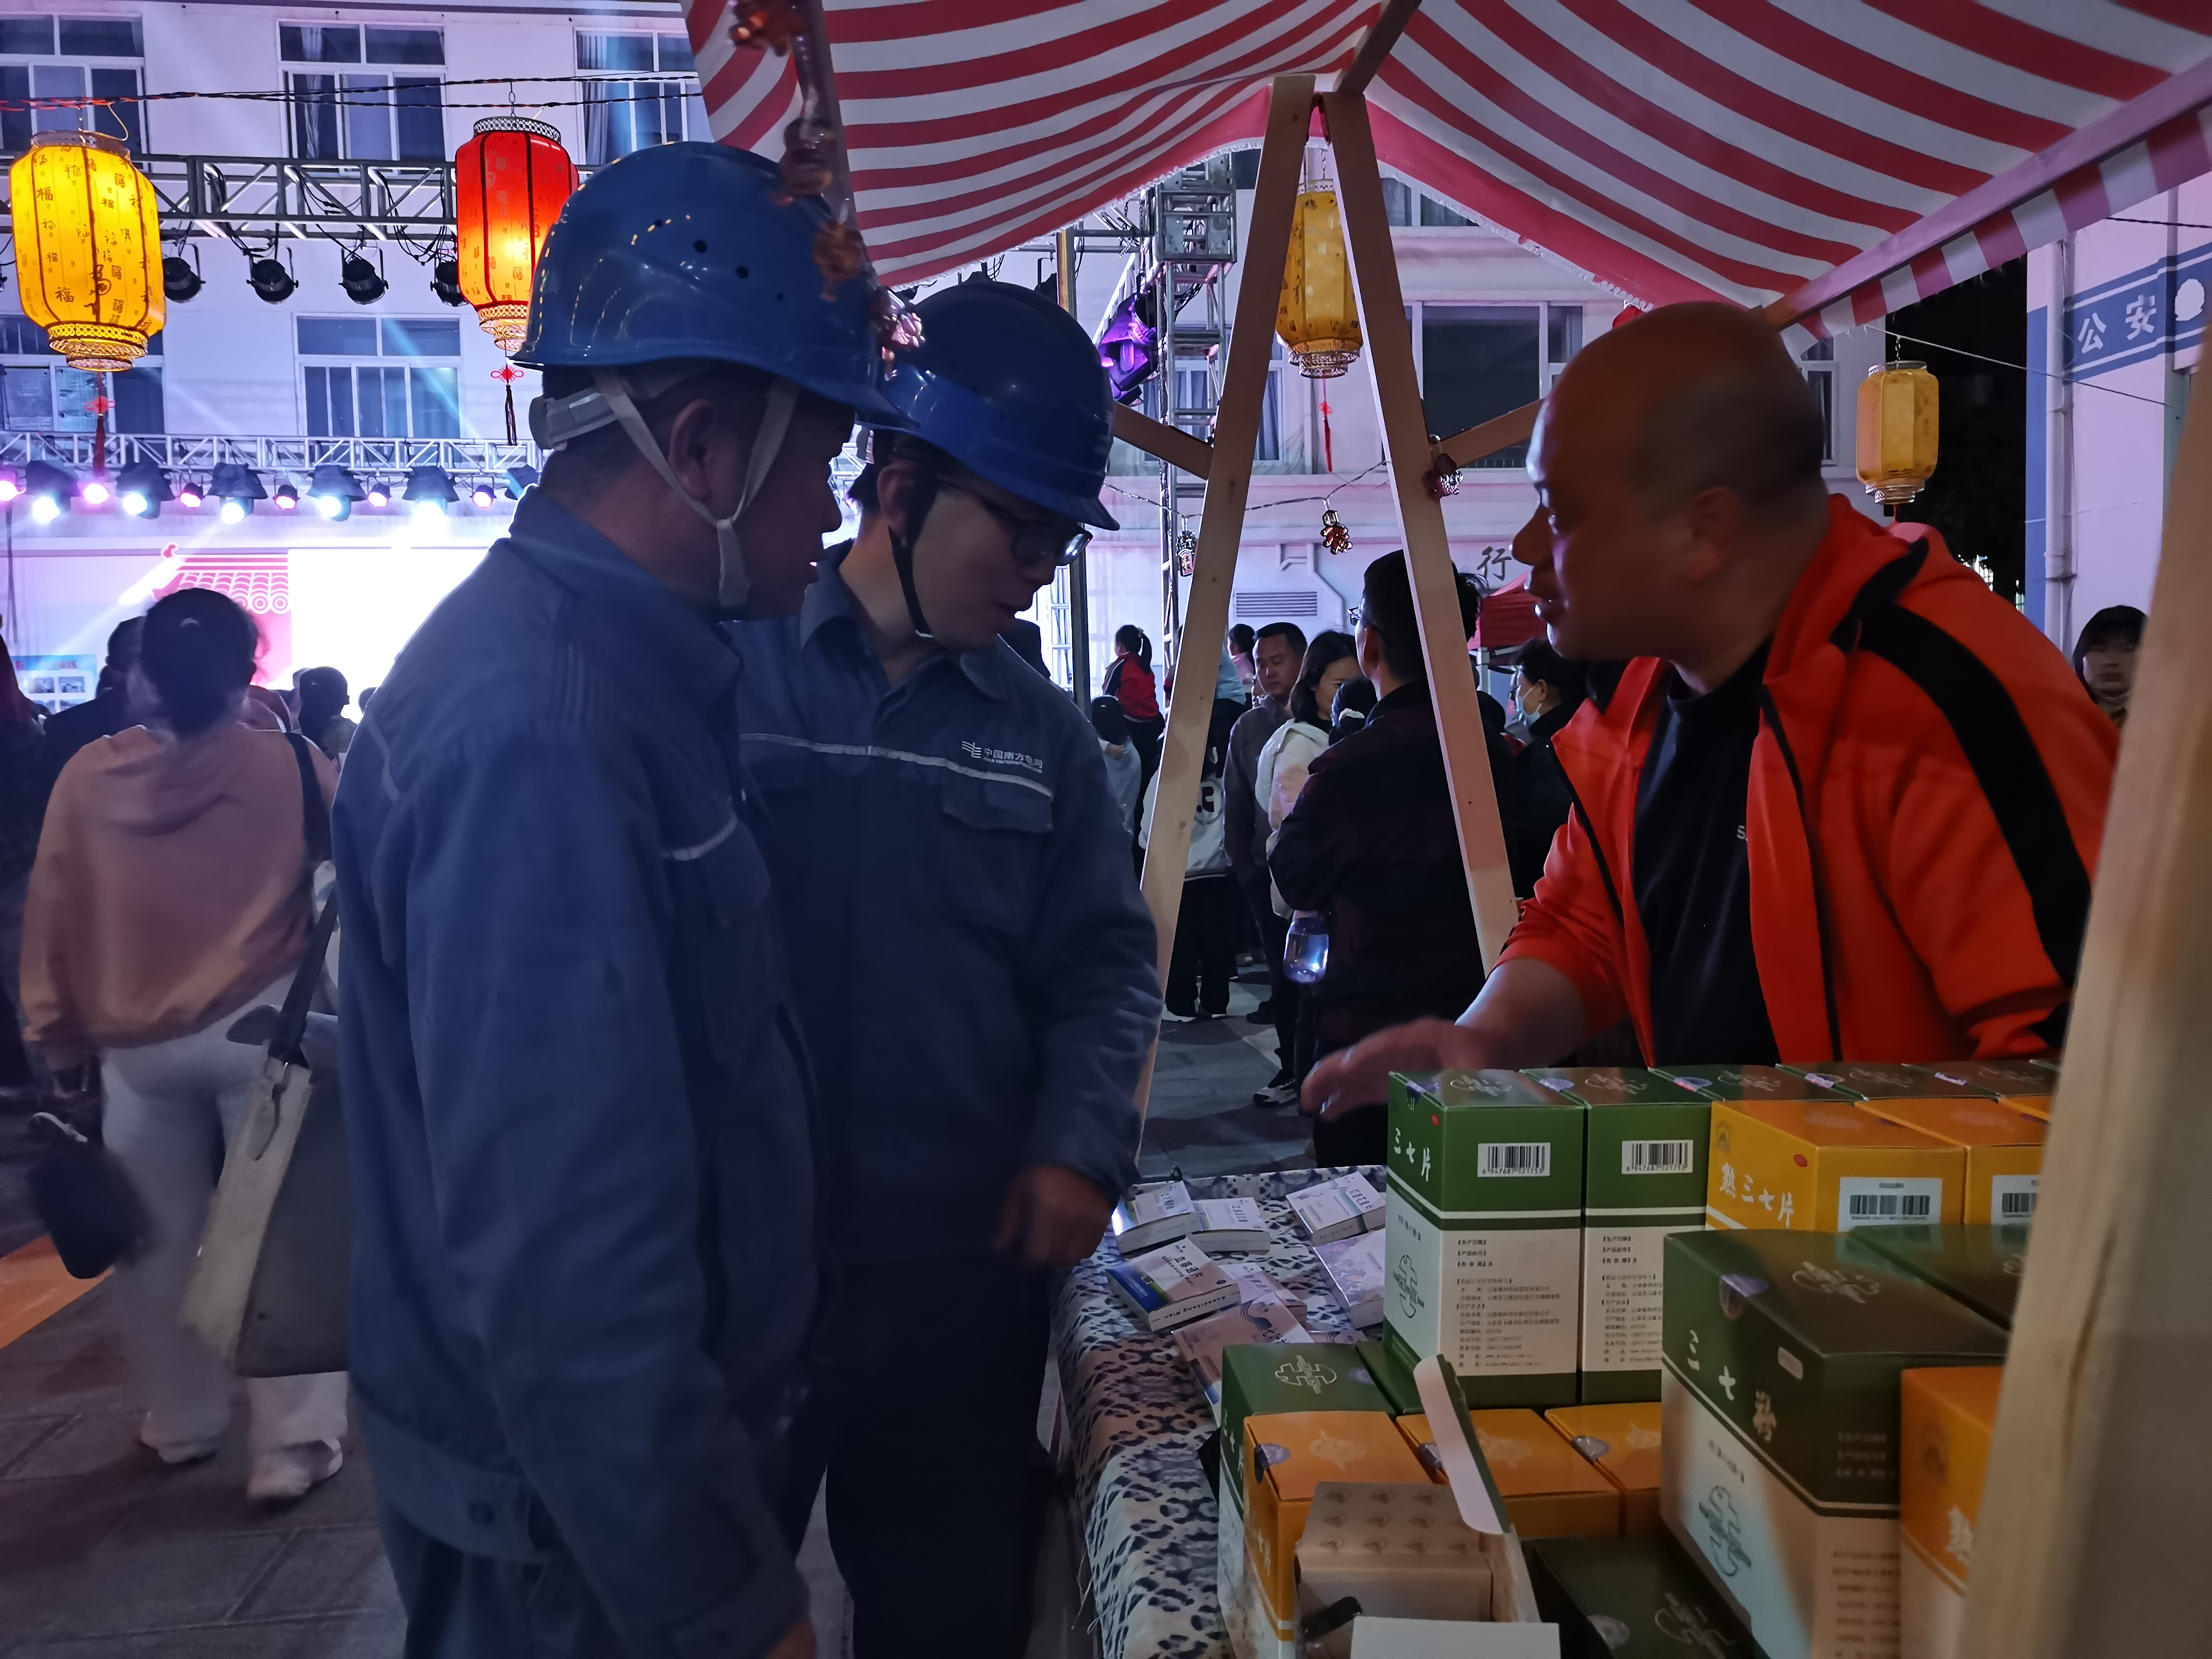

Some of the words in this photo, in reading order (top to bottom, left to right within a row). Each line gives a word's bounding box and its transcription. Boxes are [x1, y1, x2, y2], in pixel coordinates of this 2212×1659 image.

[2078, 294, 2156, 354] 公安
[1394, 1127, 1431, 1182] 三七片
